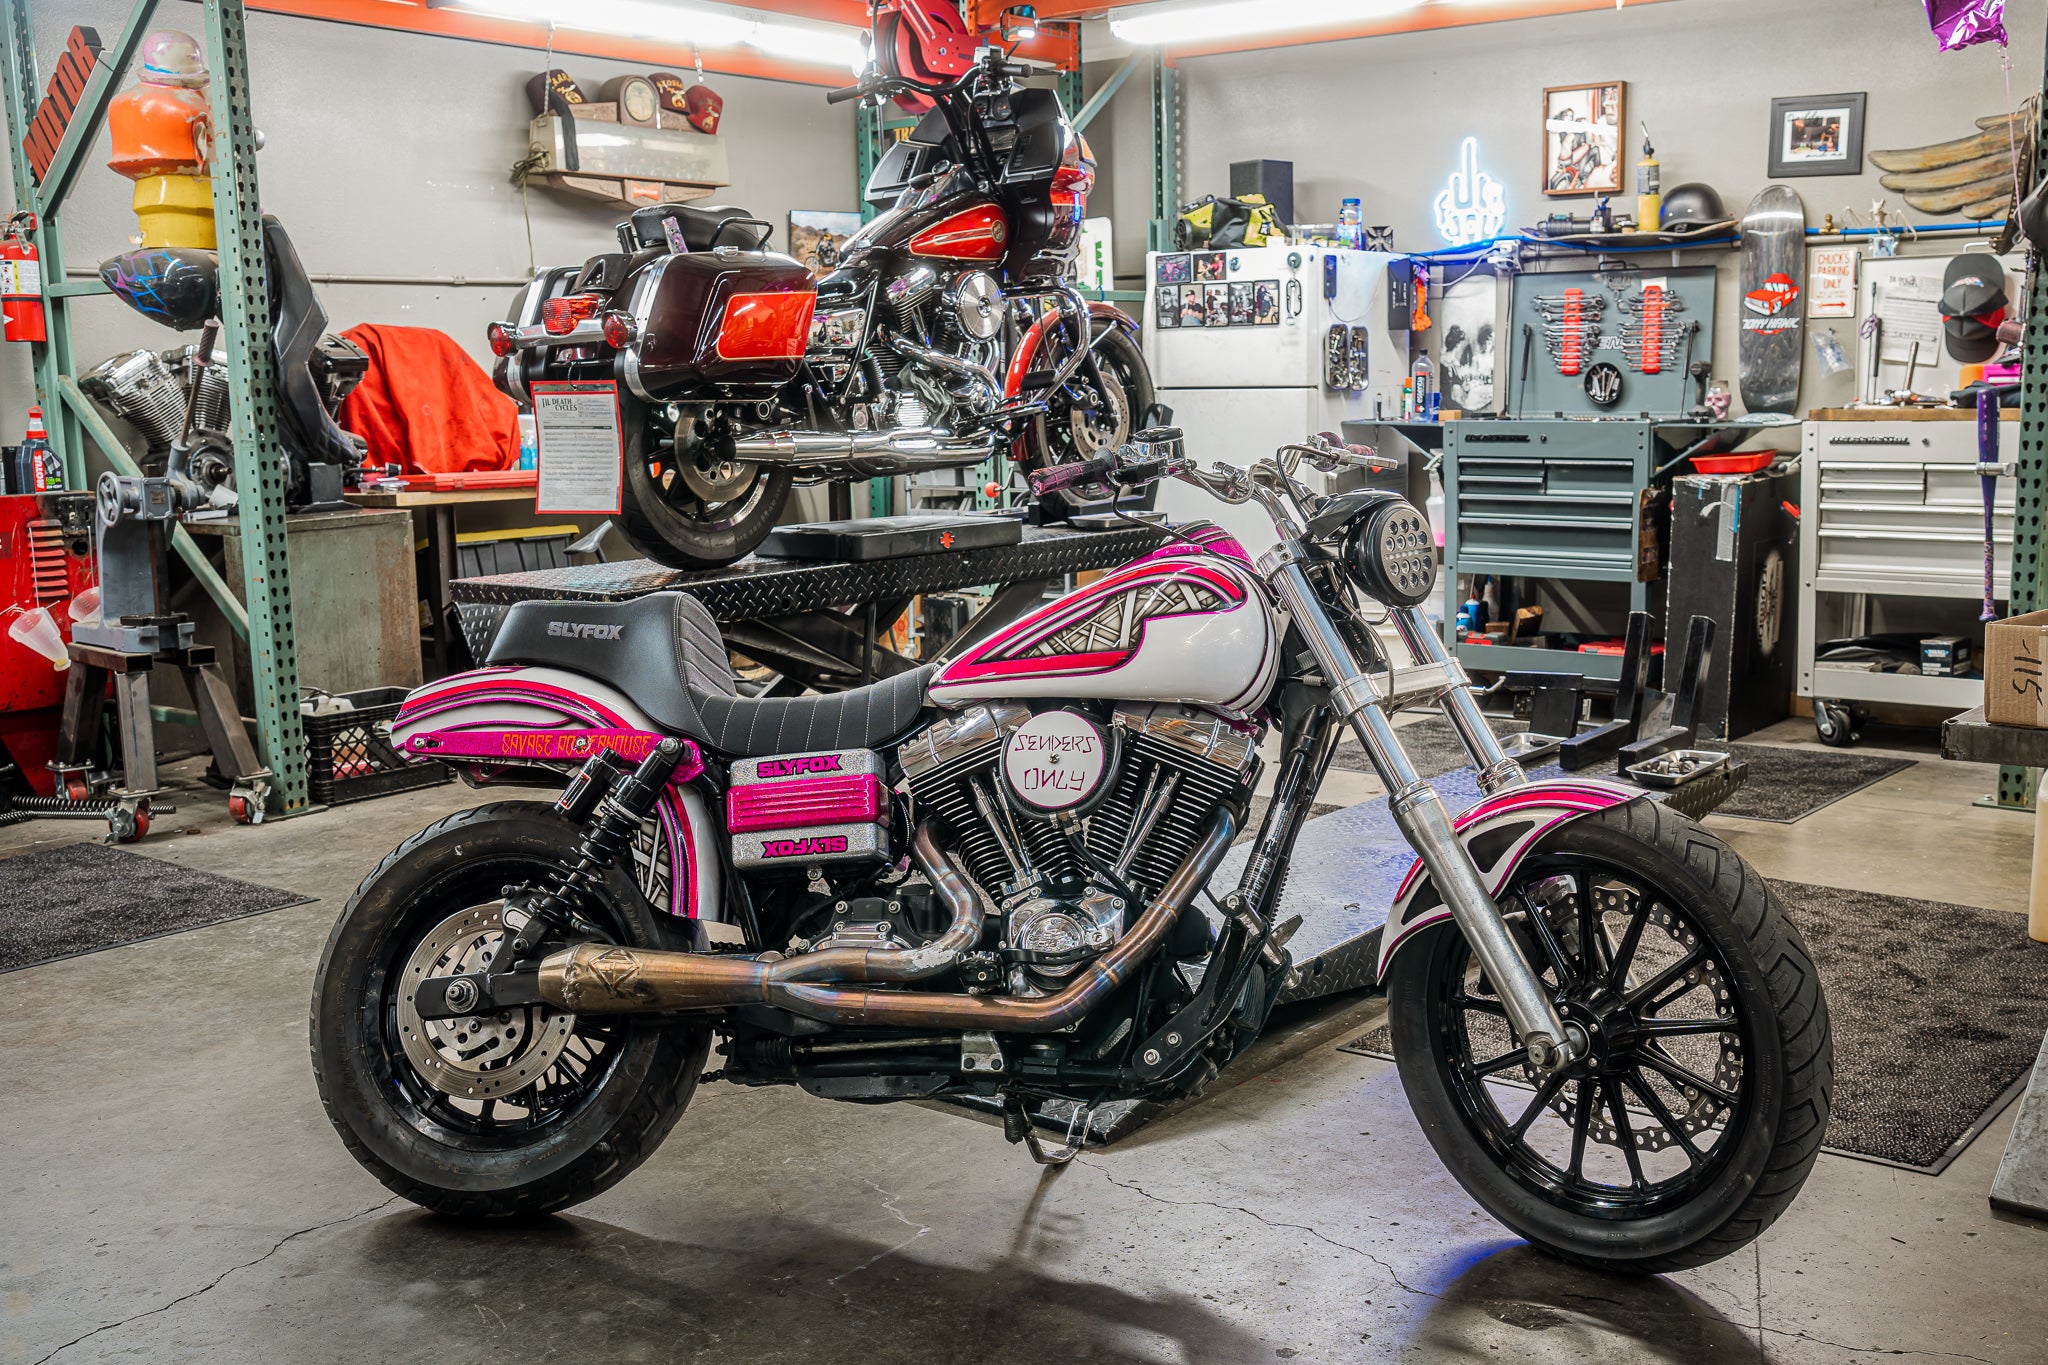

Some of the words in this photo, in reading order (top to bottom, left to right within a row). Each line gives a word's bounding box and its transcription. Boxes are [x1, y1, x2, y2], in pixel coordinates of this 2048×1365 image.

[22, 24, 98, 185] MOTOR
[1817, 253, 1850, 265] CHUCK'S
[1817, 265, 1849, 276] PARKING
[1823, 278, 1842, 289] ONLY
[1742, 318, 1768, 330] TONY
[1766, 317, 1800, 329] HAWK
[555, 404, 578, 412] CYCLES
[34, 454, 45, 489] MOTUL
[546, 621, 625, 640] SLYFOX
[501, 733, 554, 757] SAVAGE
[556, 733, 652, 758] POERHOUSE
[1014, 734, 1096, 753] SENDERS
[757, 754, 843, 779] SLYFOX
[1023, 767, 1086, 792] ONLY
[760, 835, 849, 859] SLYFOX
